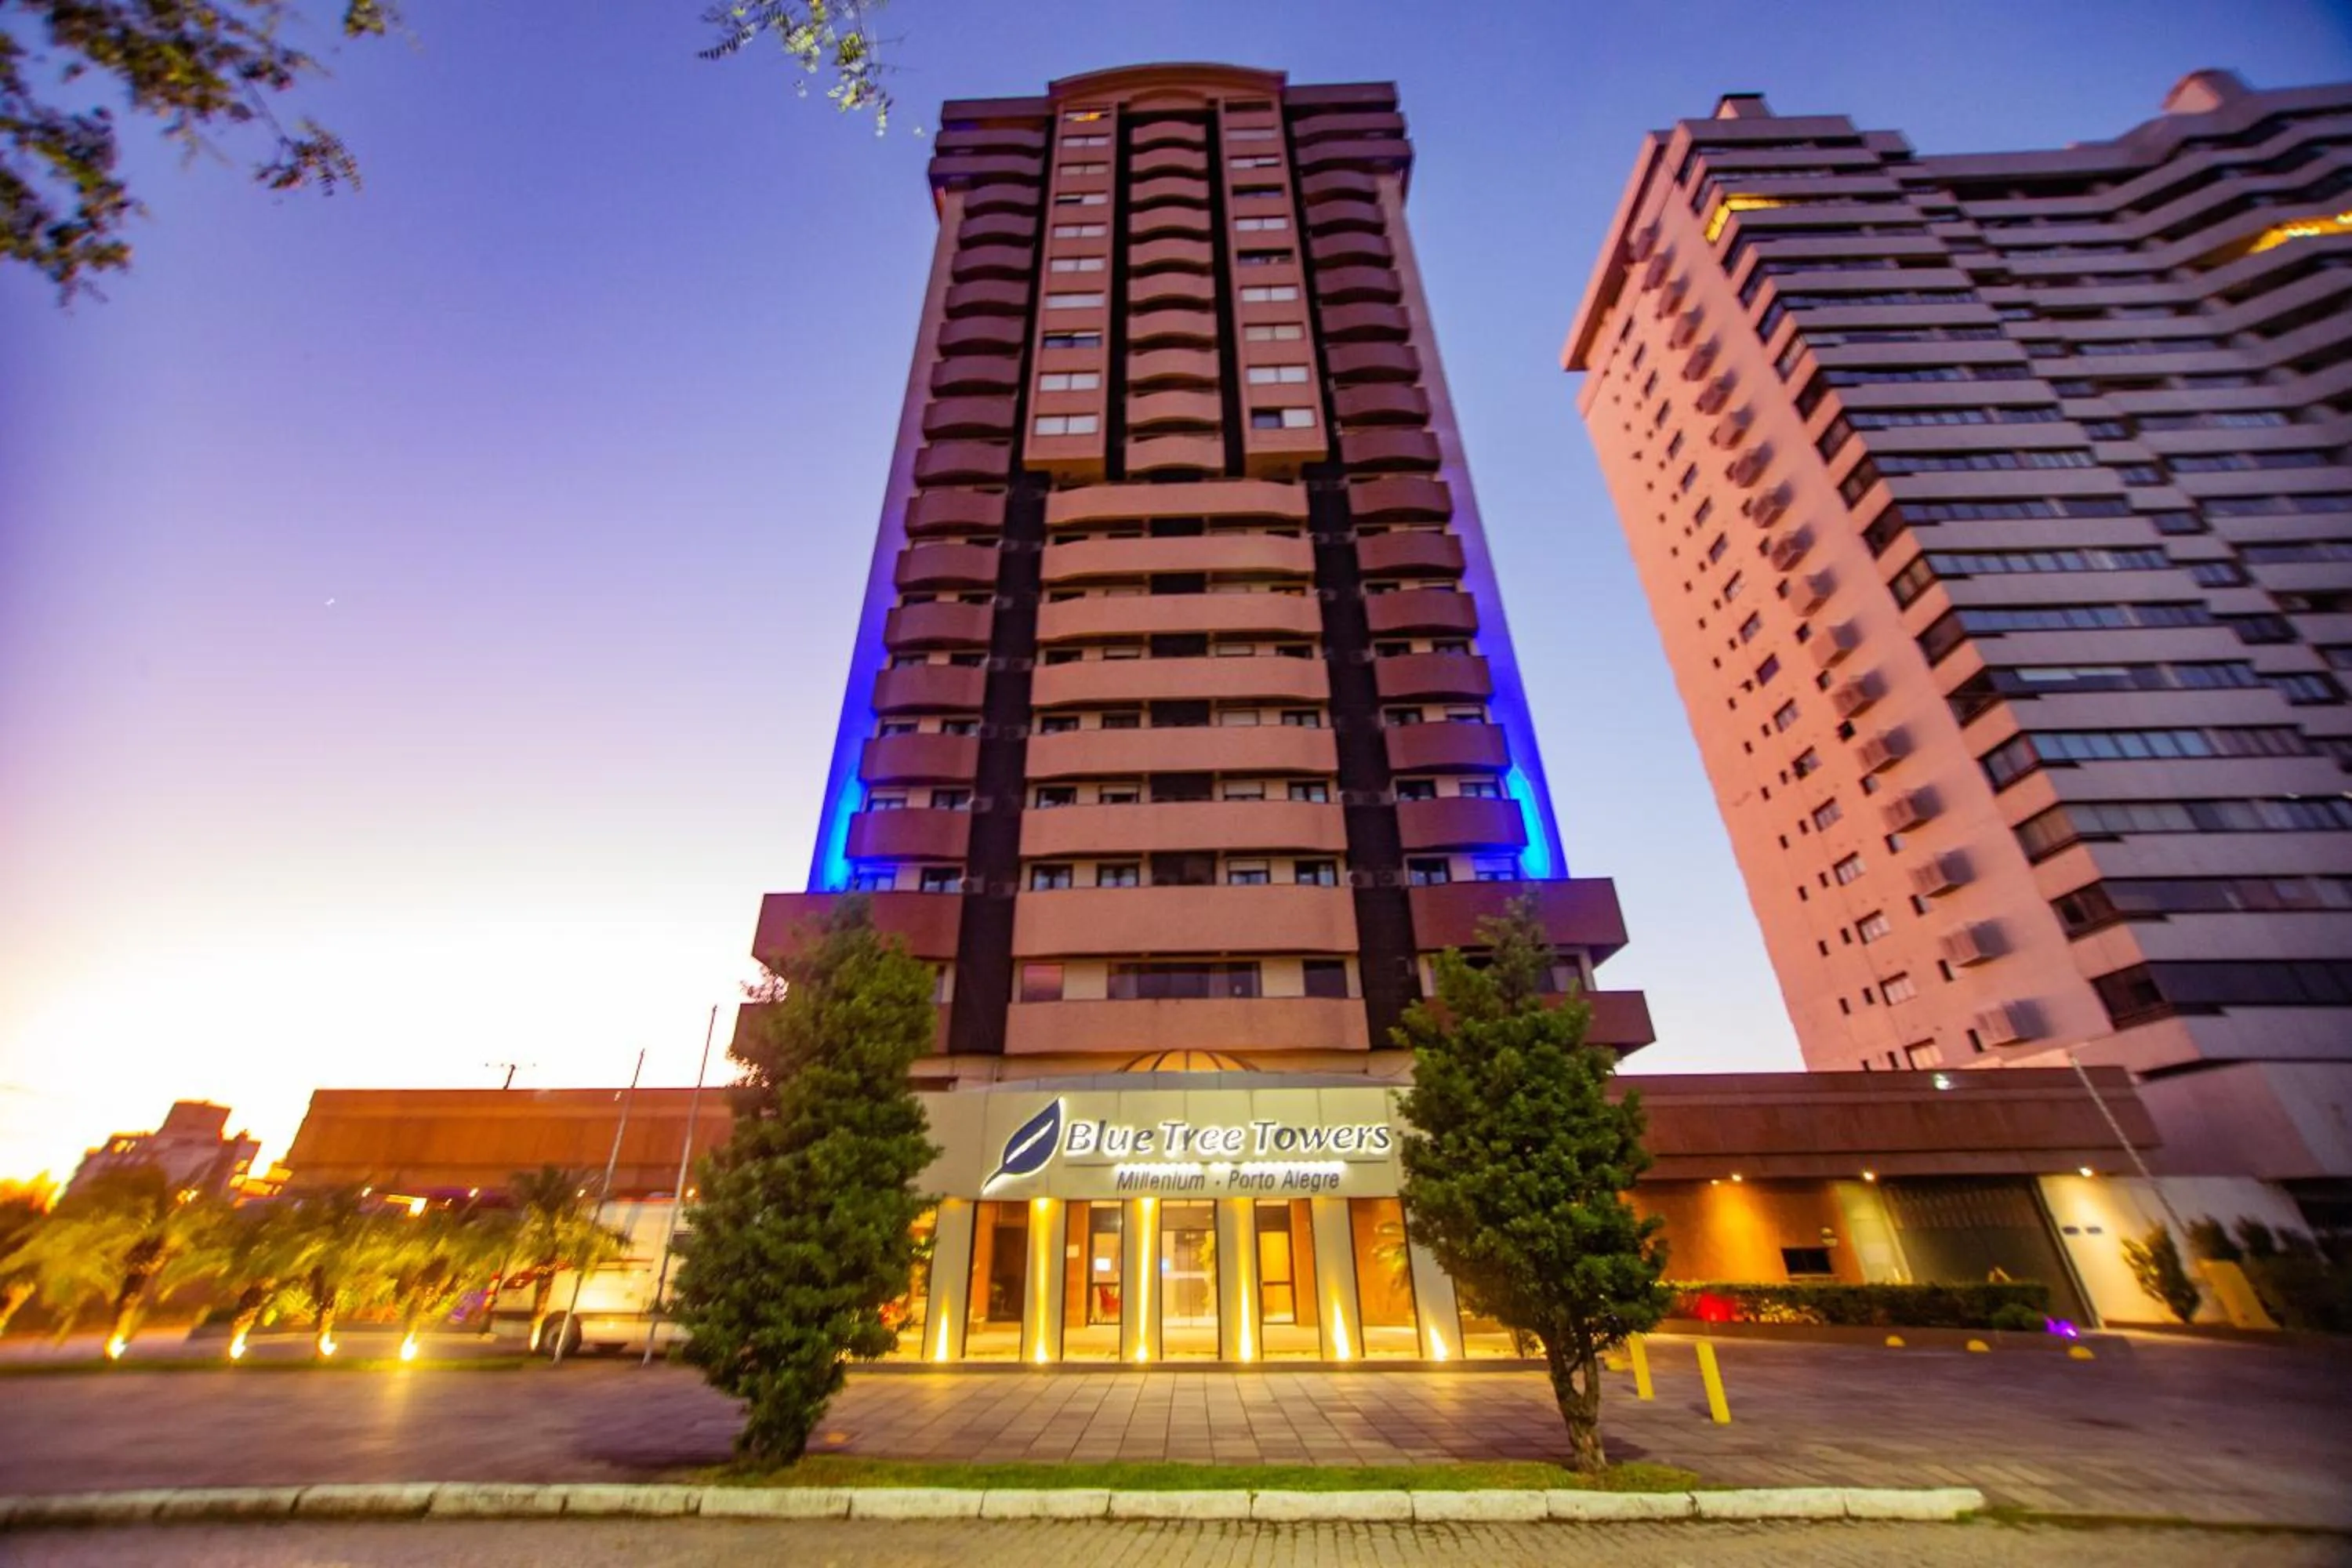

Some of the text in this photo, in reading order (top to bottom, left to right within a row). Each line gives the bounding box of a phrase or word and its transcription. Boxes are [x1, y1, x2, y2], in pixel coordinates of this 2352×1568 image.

[1065, 1119, 1391, 1152] Blue Tree Towers
[1116, 1169, 1341, 1192] Millenium Porto Alegre
